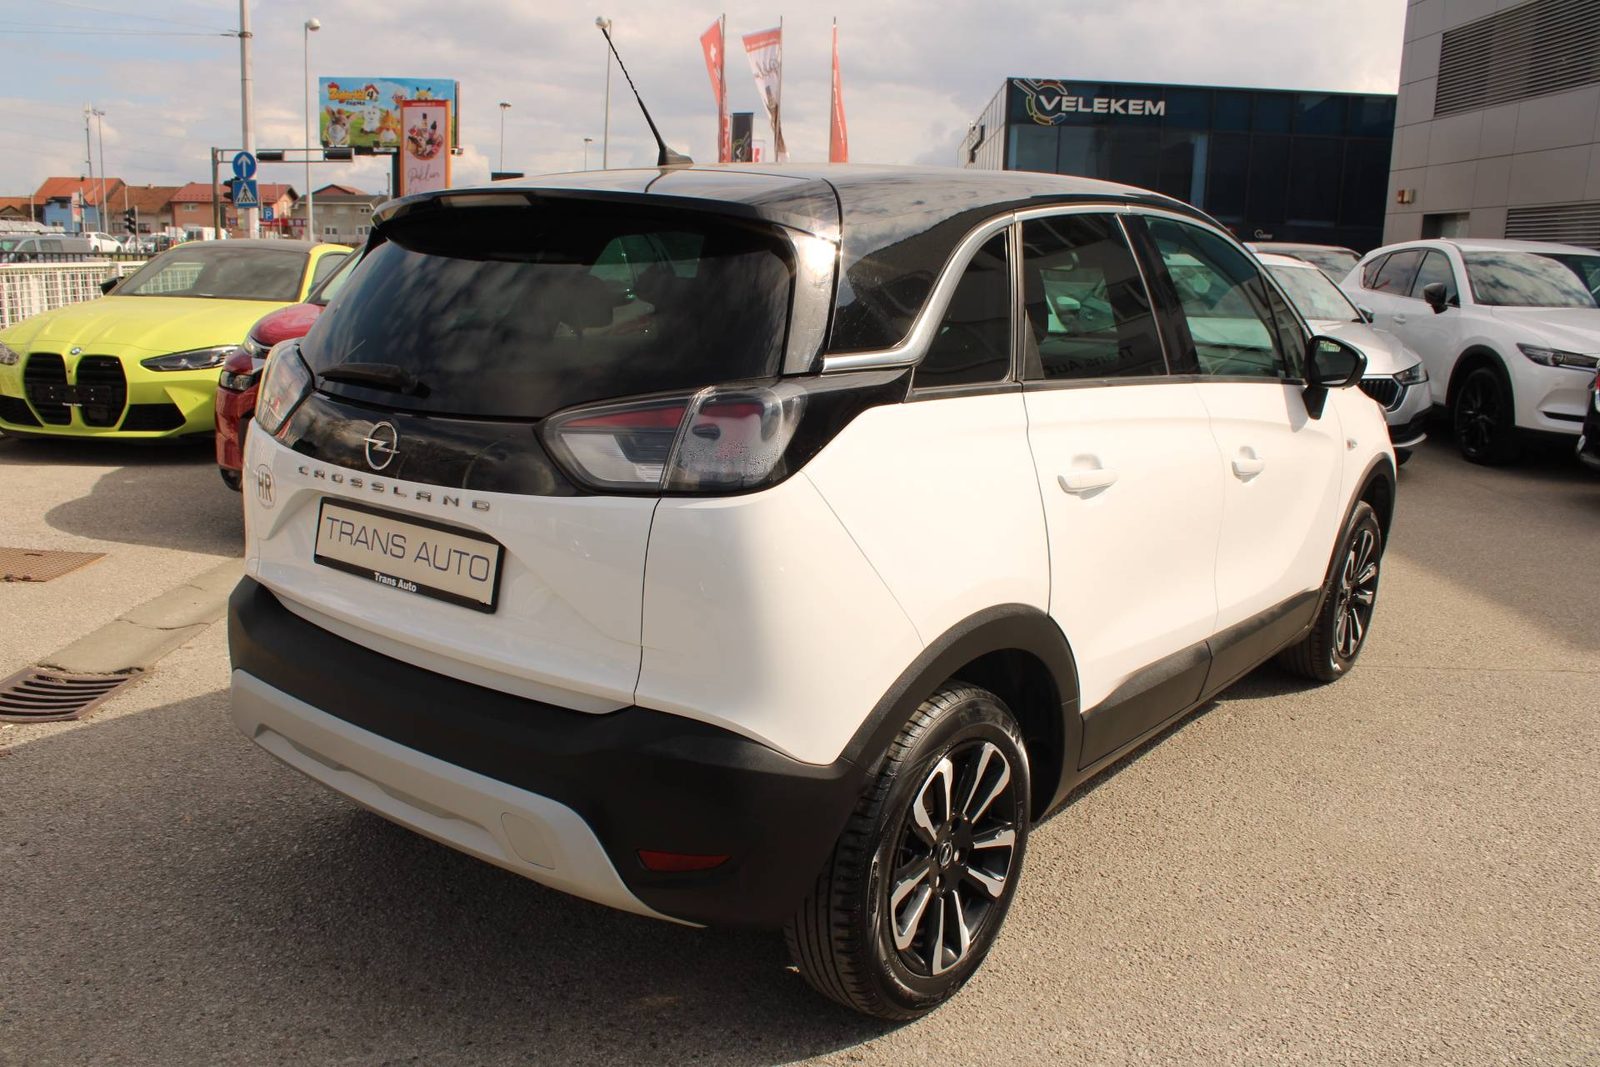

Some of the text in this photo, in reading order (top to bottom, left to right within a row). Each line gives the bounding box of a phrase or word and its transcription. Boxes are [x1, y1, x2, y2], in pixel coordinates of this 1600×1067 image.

[1039, 95, 1165, 116] VELEKEM
[265, 211, 273, 221] P
[257, 470, 272, 502] HR
[298, 465, 491, 511] CROSSLAND
[325, 515, 490, 582] TRANS AUTO
[374, 571, 417, 592] Trans Auto
